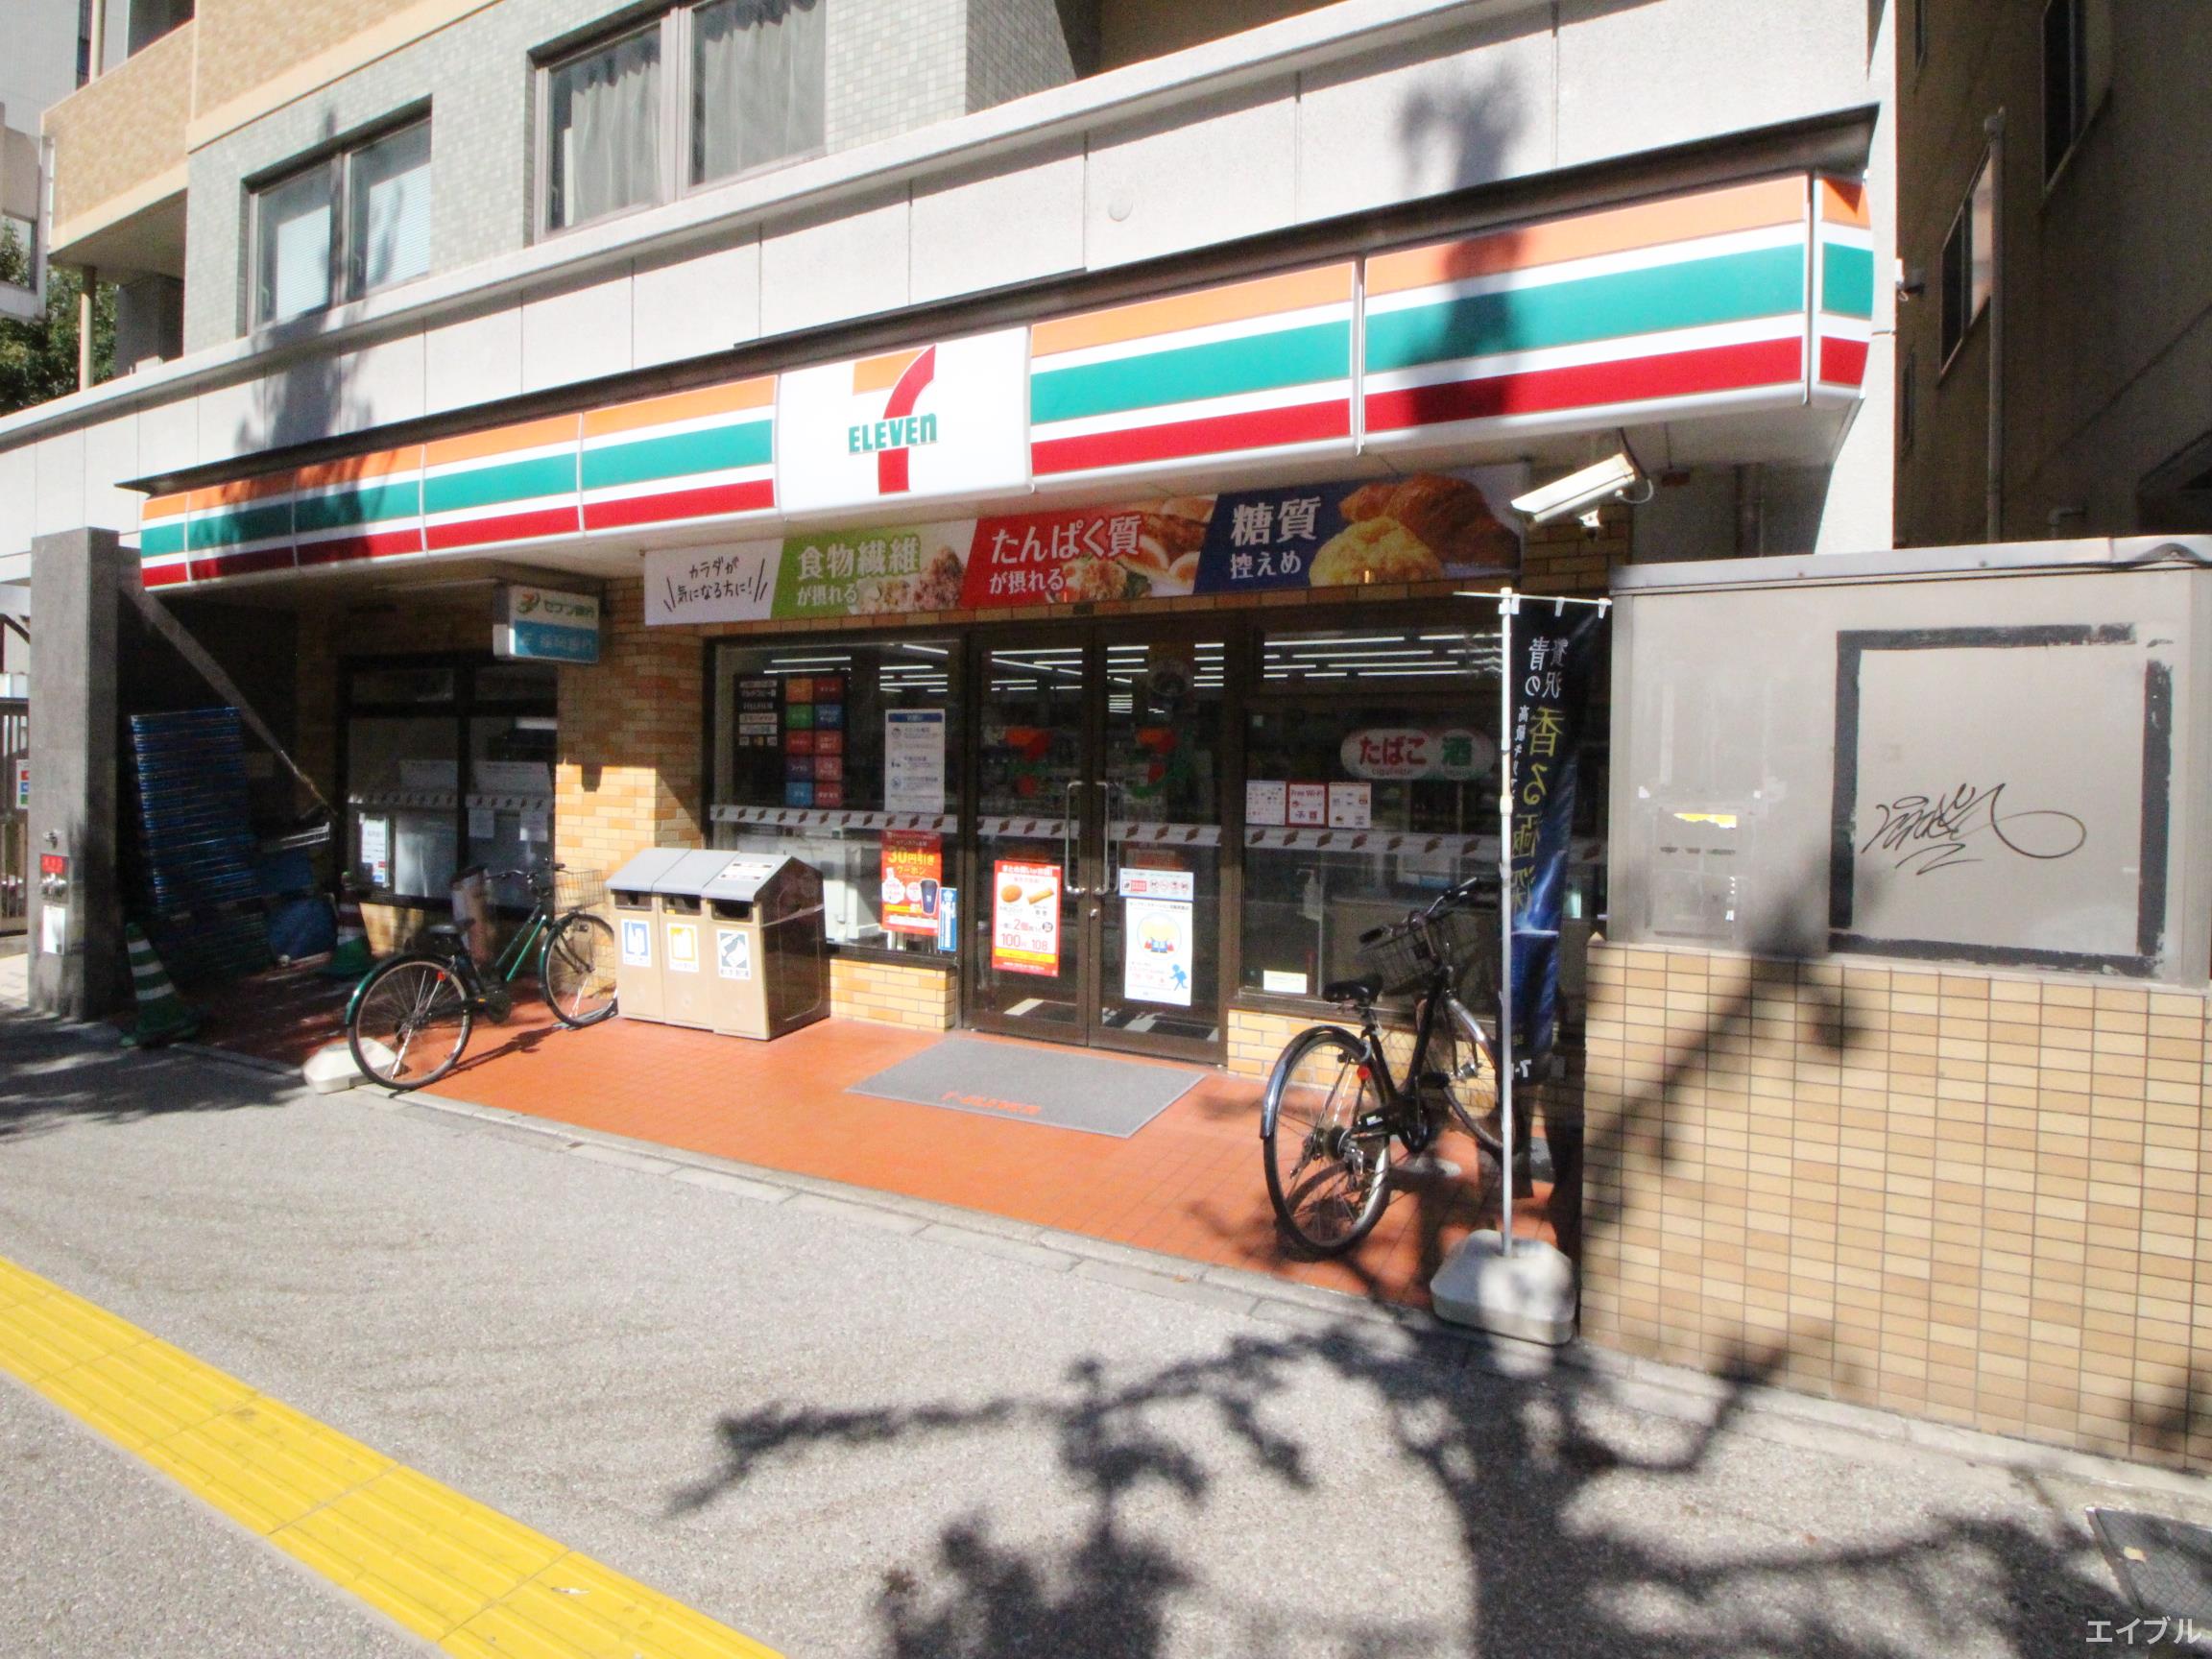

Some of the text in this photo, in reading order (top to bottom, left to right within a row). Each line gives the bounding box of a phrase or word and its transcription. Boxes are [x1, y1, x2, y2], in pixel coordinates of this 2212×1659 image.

[852, 344, 937, 494] 7
[1230, 496, 1322, 546] 糖質
[991, 515, 1142, 565] たんぱく質
[689, 556, 739, 579] カラダが
[797, 533, 921, 580] 食物繊維
[1230, 550, 1302, 580] 控えめ
[797, 582, 858, 607] が摂れる
[989, 567, 1065, 597] が摂れる
[1359, 735, 1428, 765] たばこ
